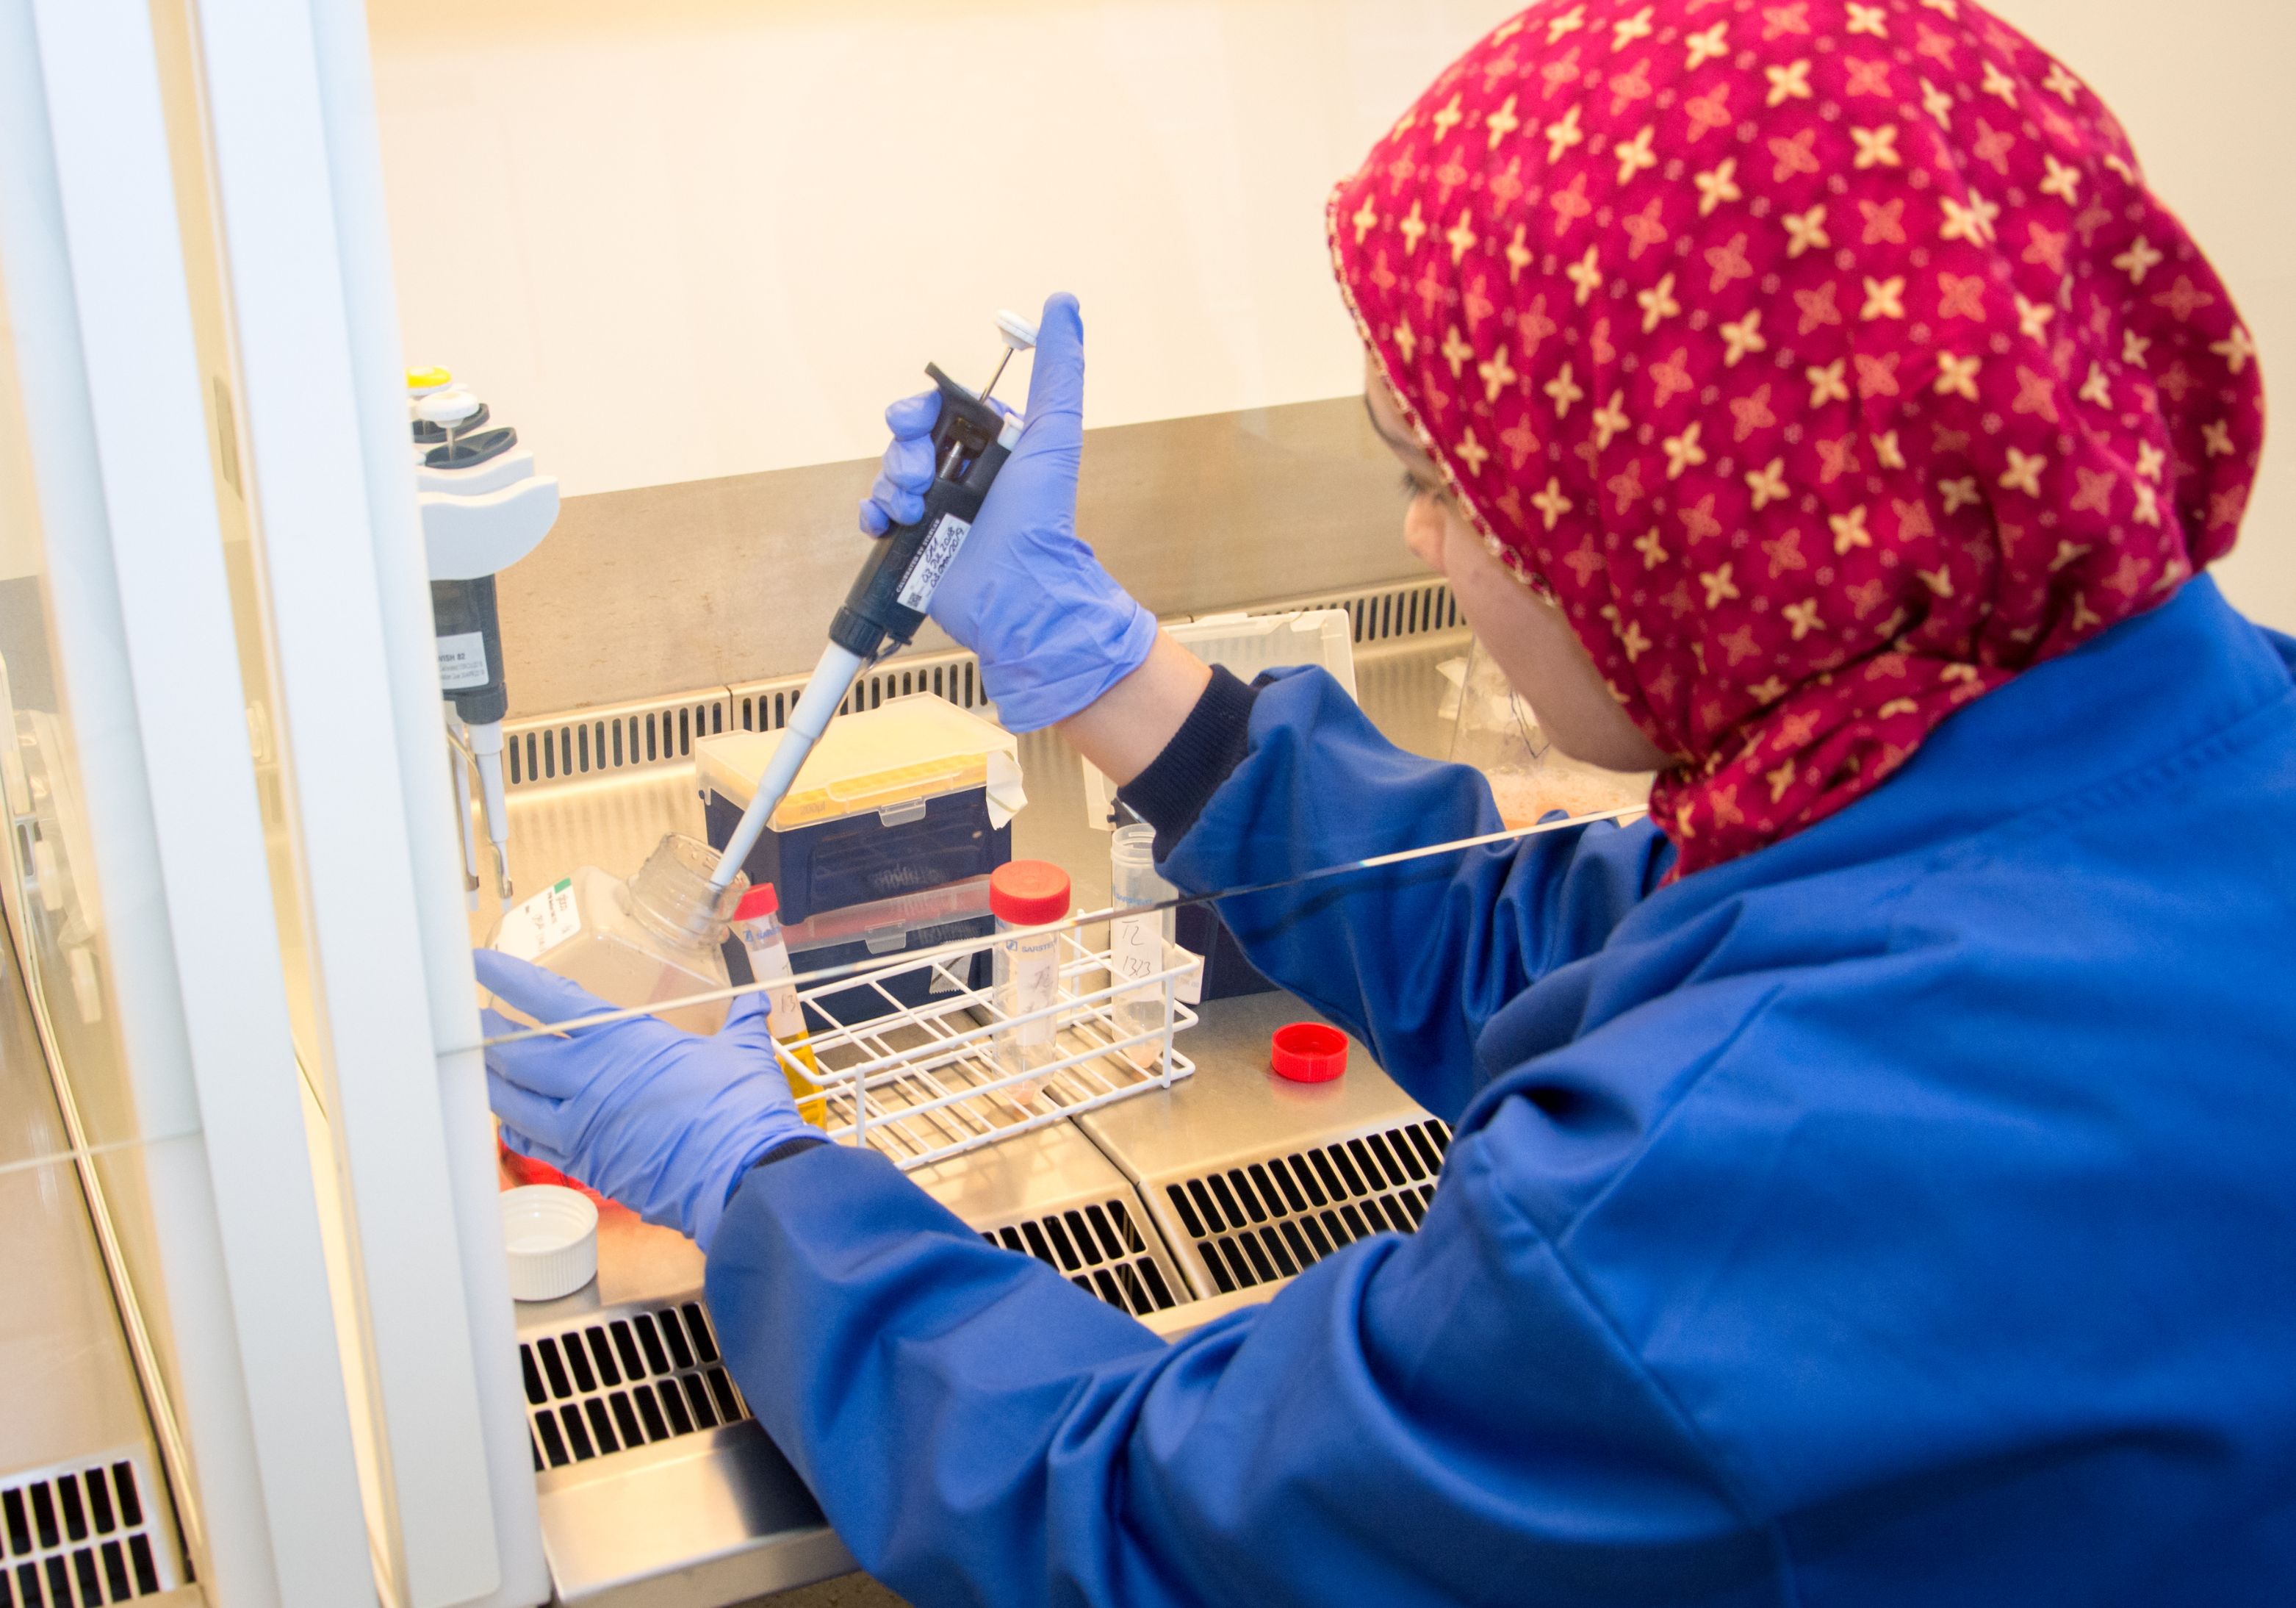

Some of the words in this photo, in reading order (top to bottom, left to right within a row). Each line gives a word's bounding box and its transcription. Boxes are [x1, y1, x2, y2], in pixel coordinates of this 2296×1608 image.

[940, 526, 955, 553] 2018
[896, 556, 920, 593] CALIBRATED
[916, 545, 925, 556] BY
[457, 653, 466, 661] 82
